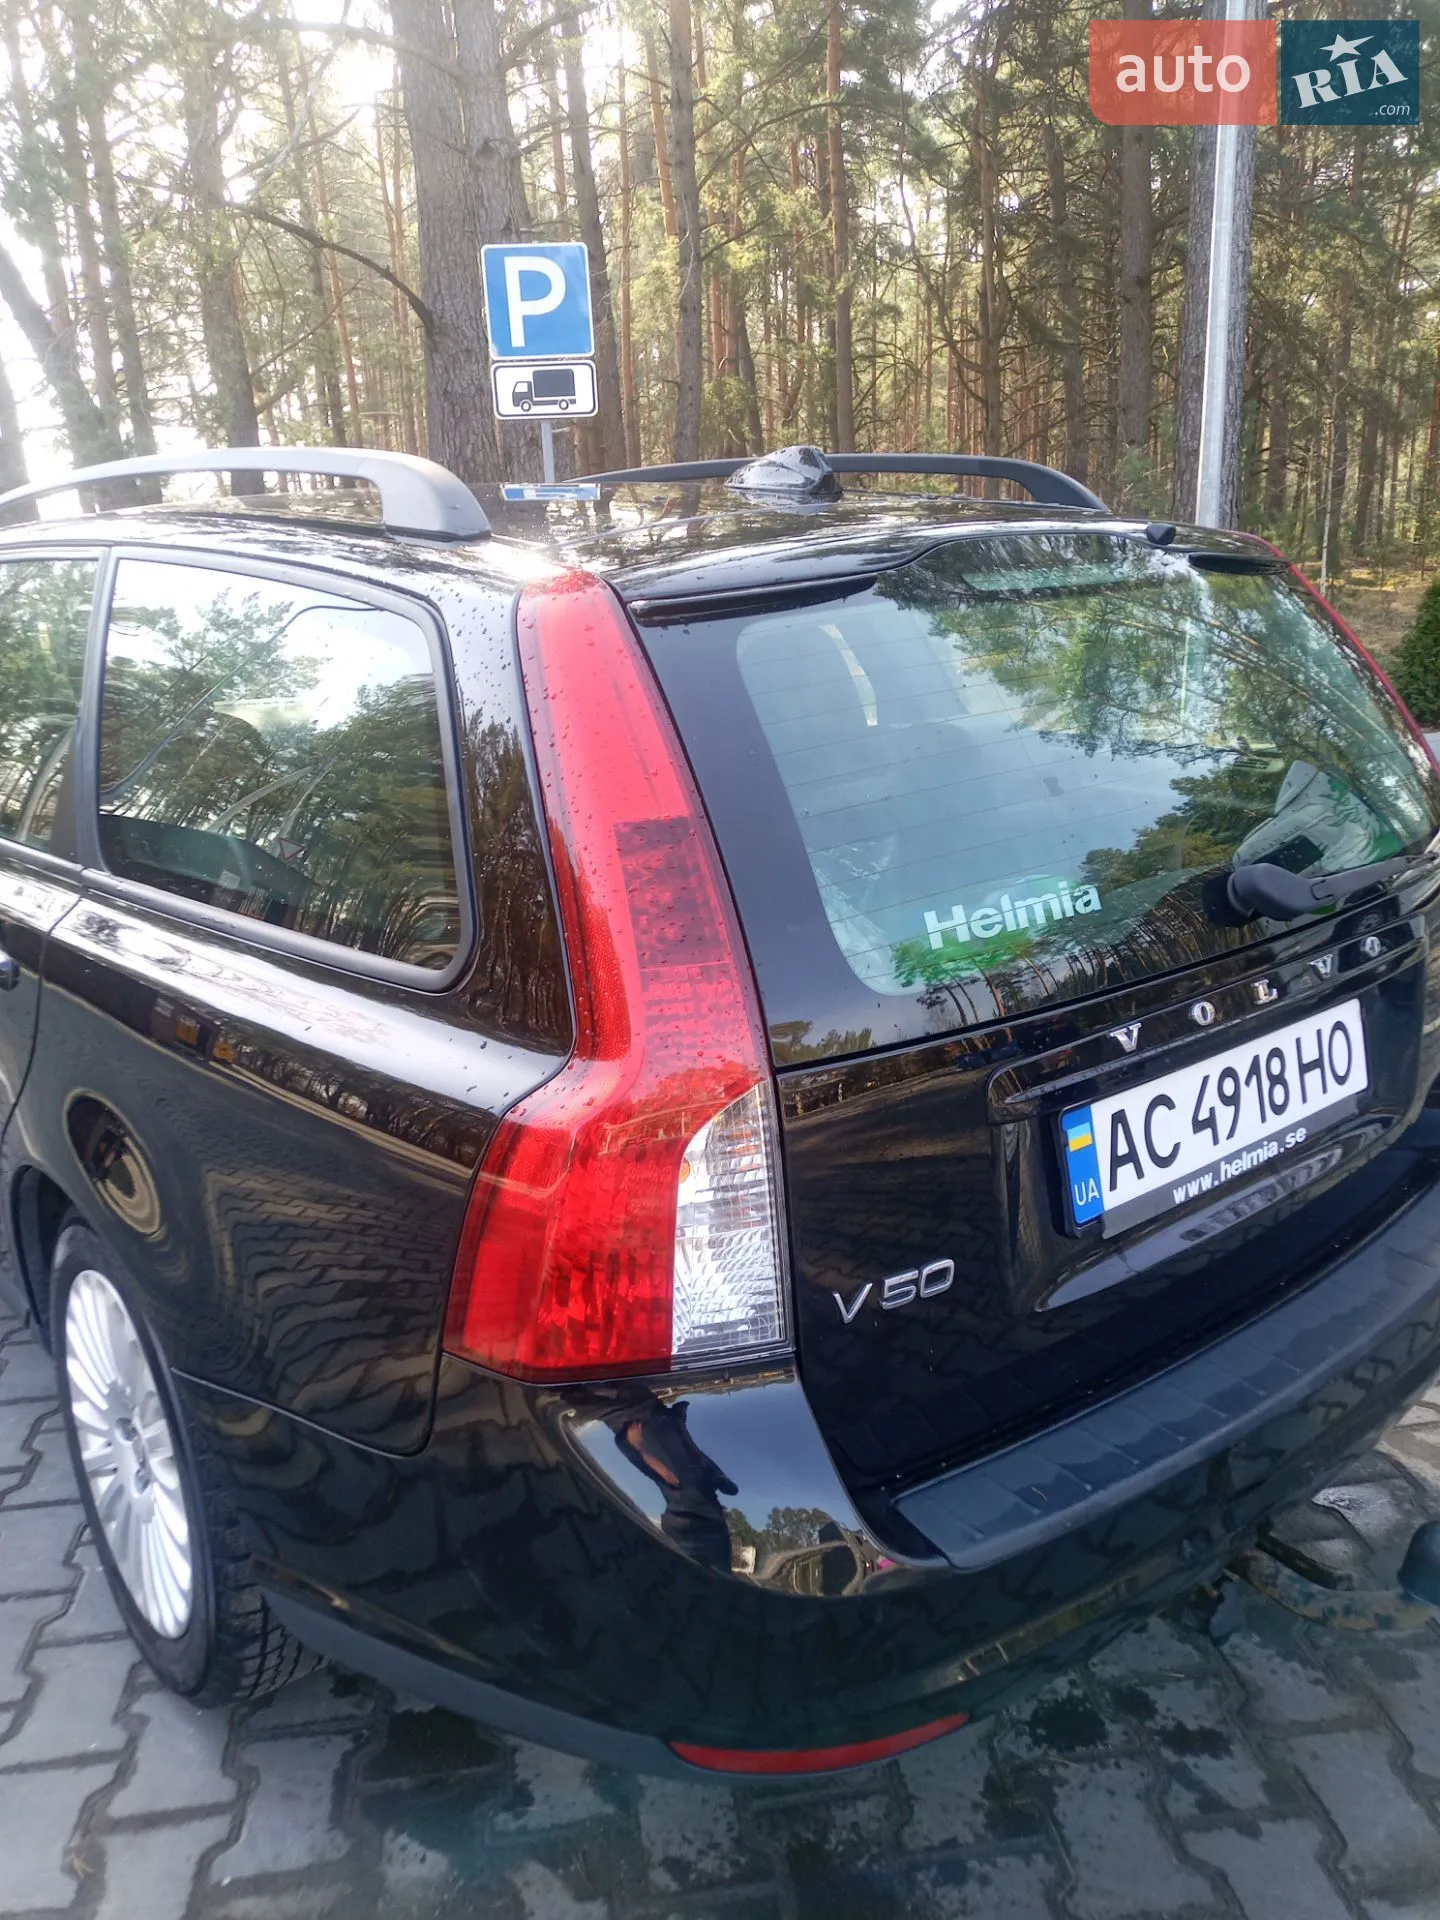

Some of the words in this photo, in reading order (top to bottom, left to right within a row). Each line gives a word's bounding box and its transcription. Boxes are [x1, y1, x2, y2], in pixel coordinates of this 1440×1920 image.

[503, 256, 566, 347] P
[923, 881, 1102, 950] Helmia
[1107, 936, 1383, 1052] VOLVO
[1109, 1093, 1182, 1192] AC
[1191, 1046, 1290, 1147] 4918
[1295, 1020, 1353, 1105] HO
[1073, 1179, 1100, 1206] UA
[1173, 1127, 1307, 1205] www.helmia.se
